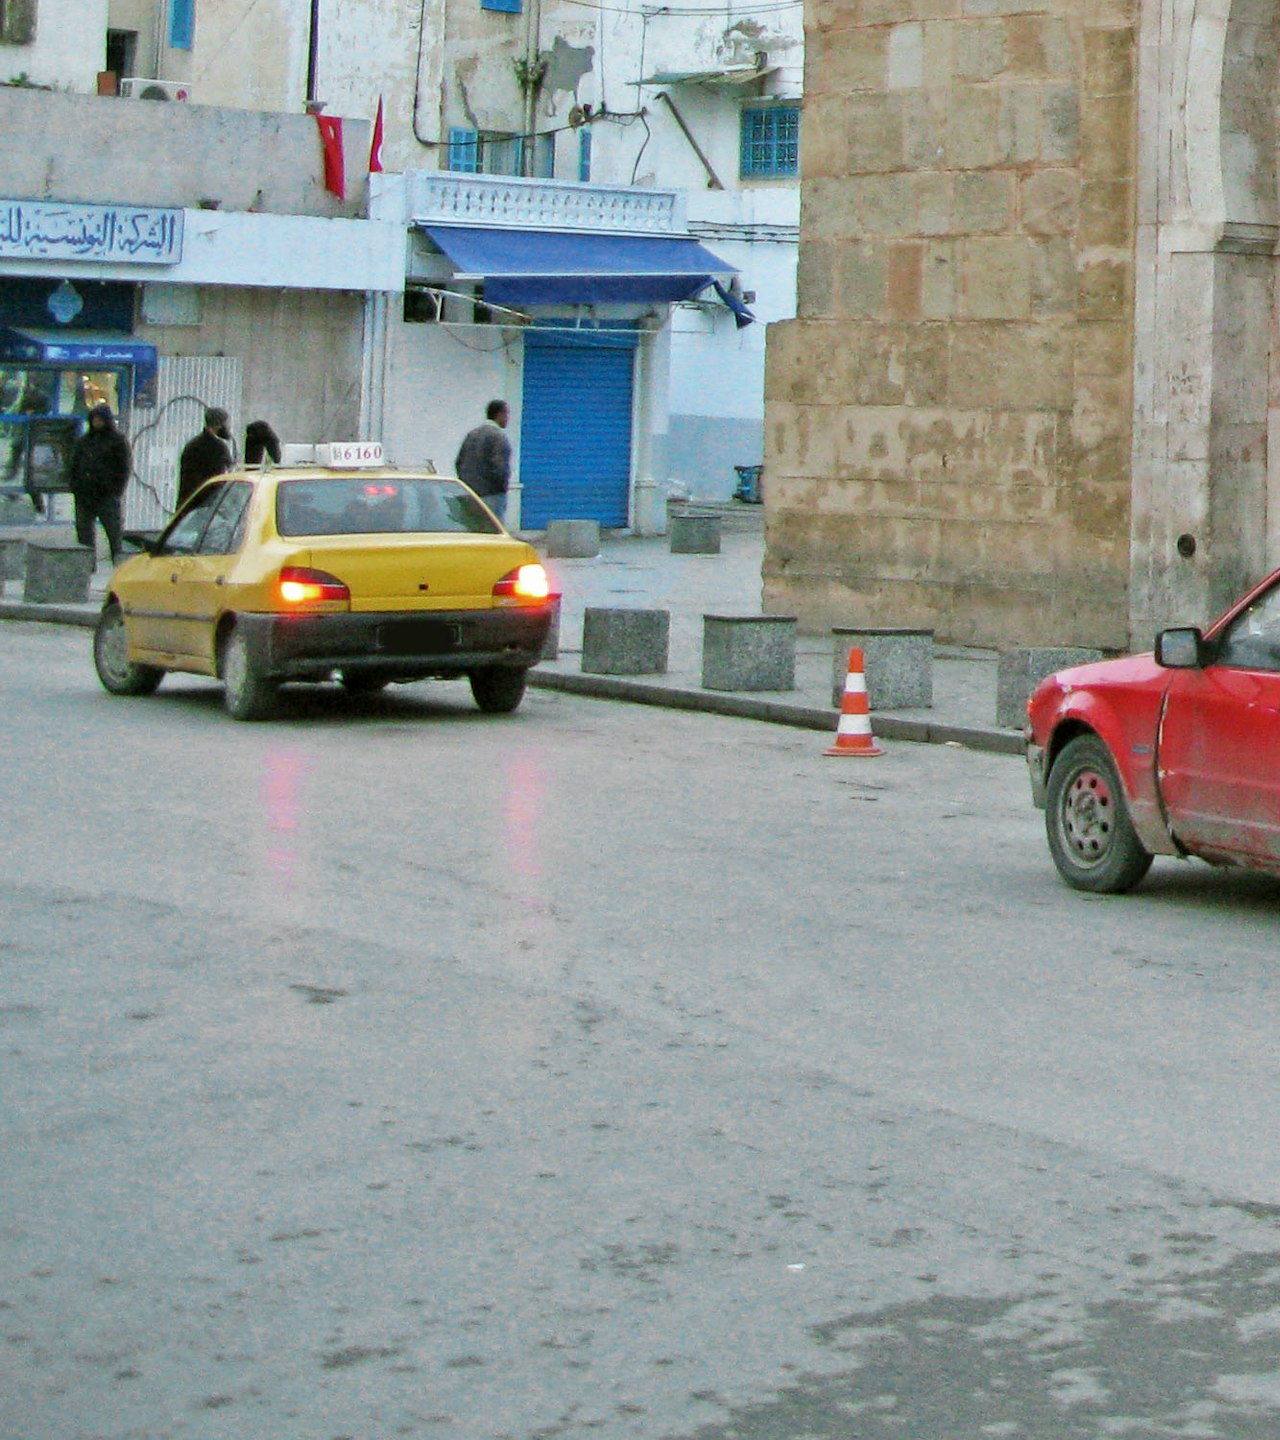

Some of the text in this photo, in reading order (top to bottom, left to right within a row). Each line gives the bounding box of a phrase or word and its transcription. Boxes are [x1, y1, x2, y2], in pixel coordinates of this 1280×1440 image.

[24, 210, 118, 257] التونسية
[117, 212, 177, 256] الشركة
[344, 445, 382, 460] 6160
